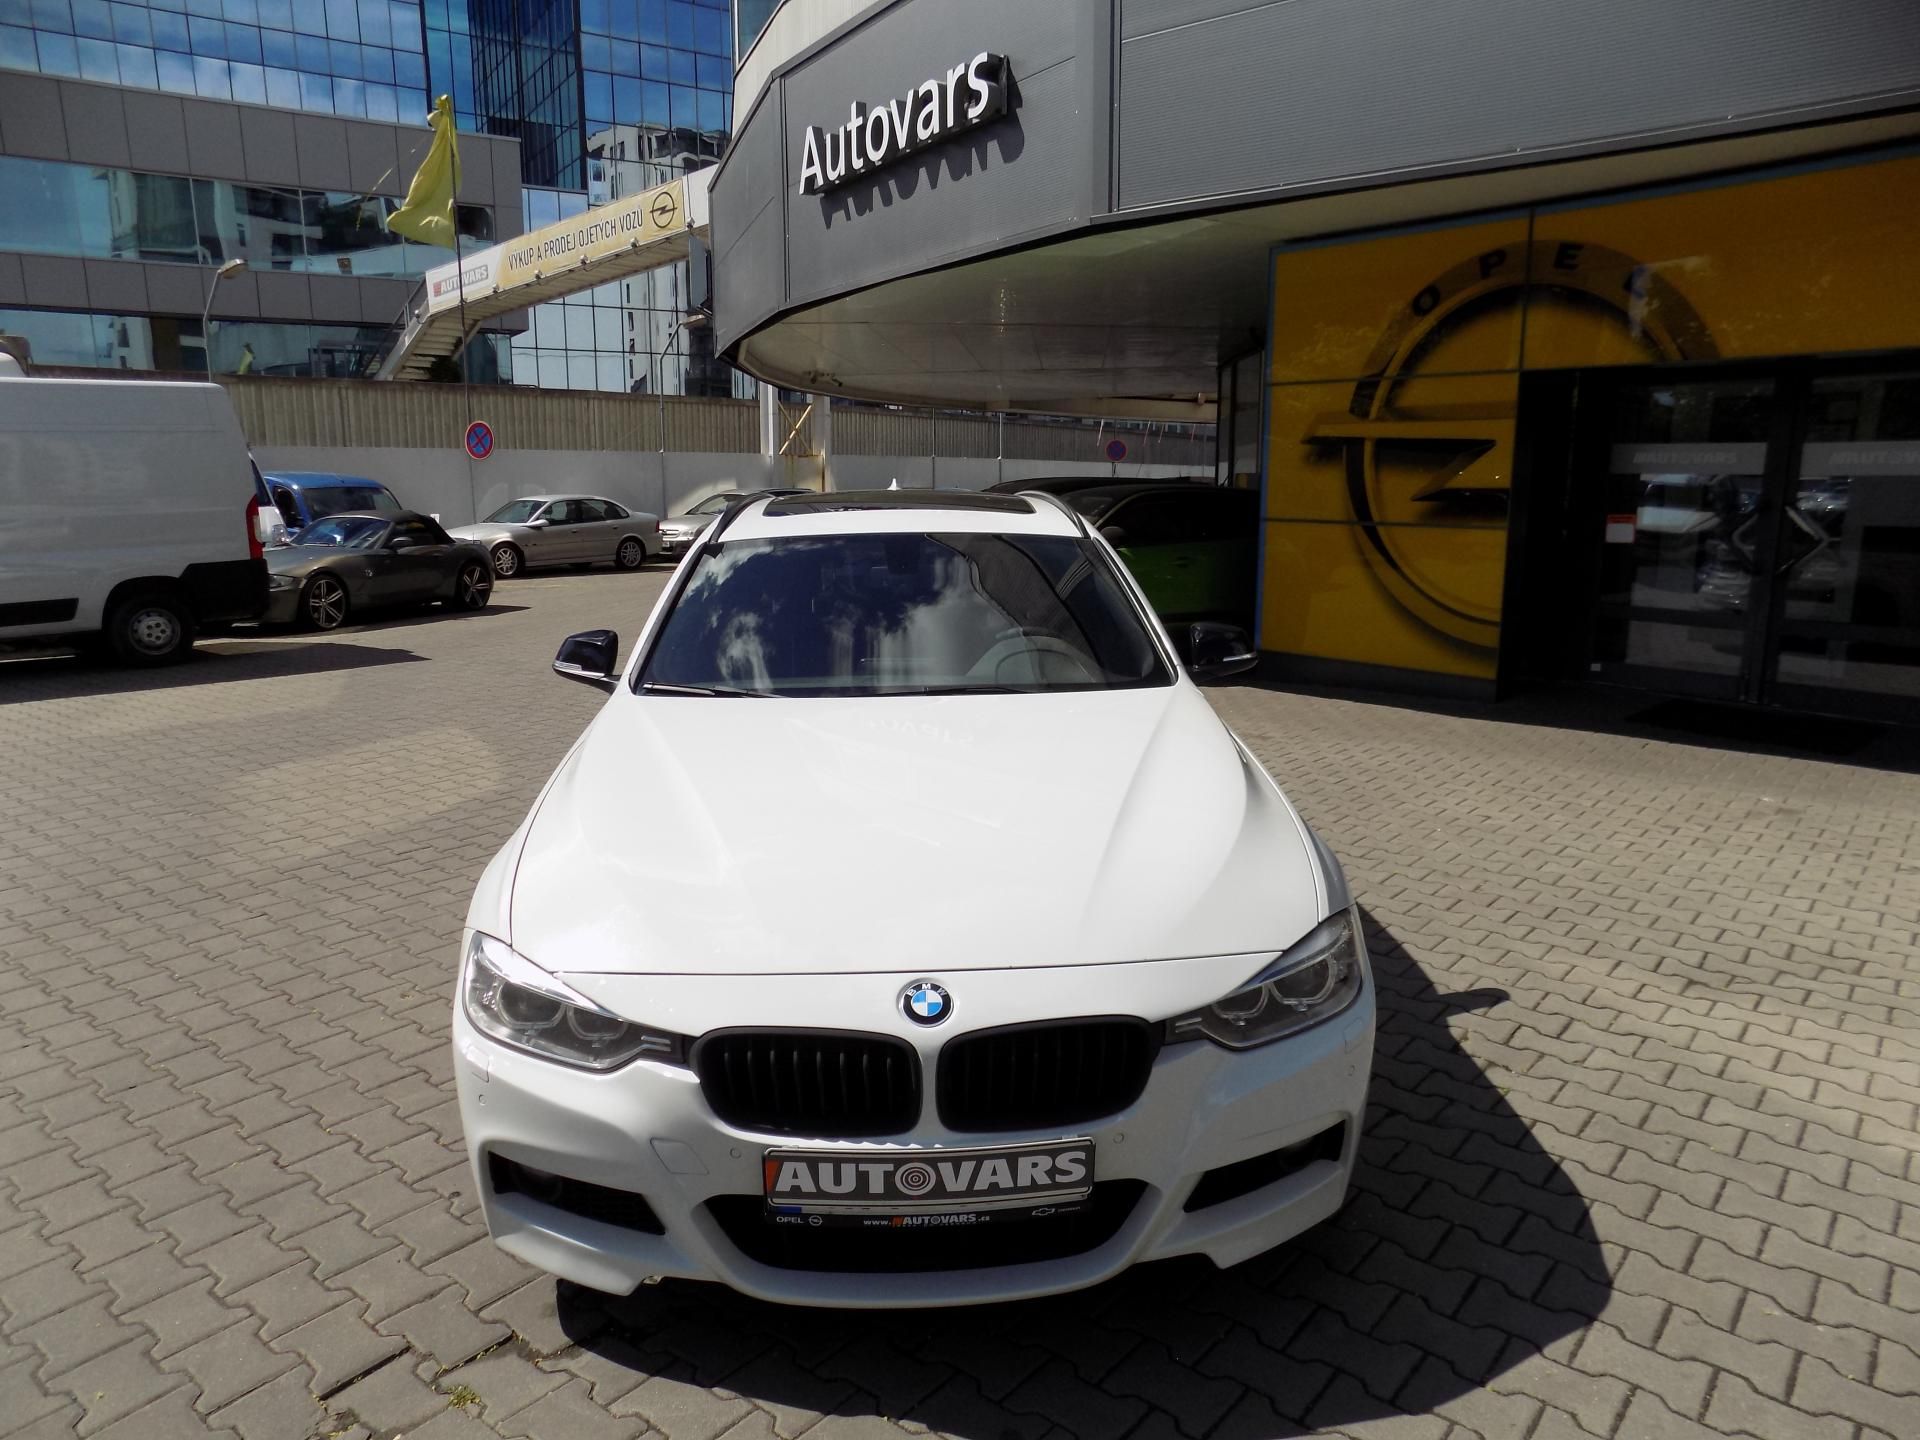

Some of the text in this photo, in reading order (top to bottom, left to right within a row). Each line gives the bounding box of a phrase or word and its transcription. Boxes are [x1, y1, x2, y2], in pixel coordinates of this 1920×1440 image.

[799, 52, 988, 195] Autovars
[537, 244, 543, 262] A
[544, 232, 576, 258] PRODEJ
[578, 218, 617, 247] OJETÝCH
[776, 1151, 1086, 1196] AUTOVARS
[776, 1216, 804, 1224] OPEL
